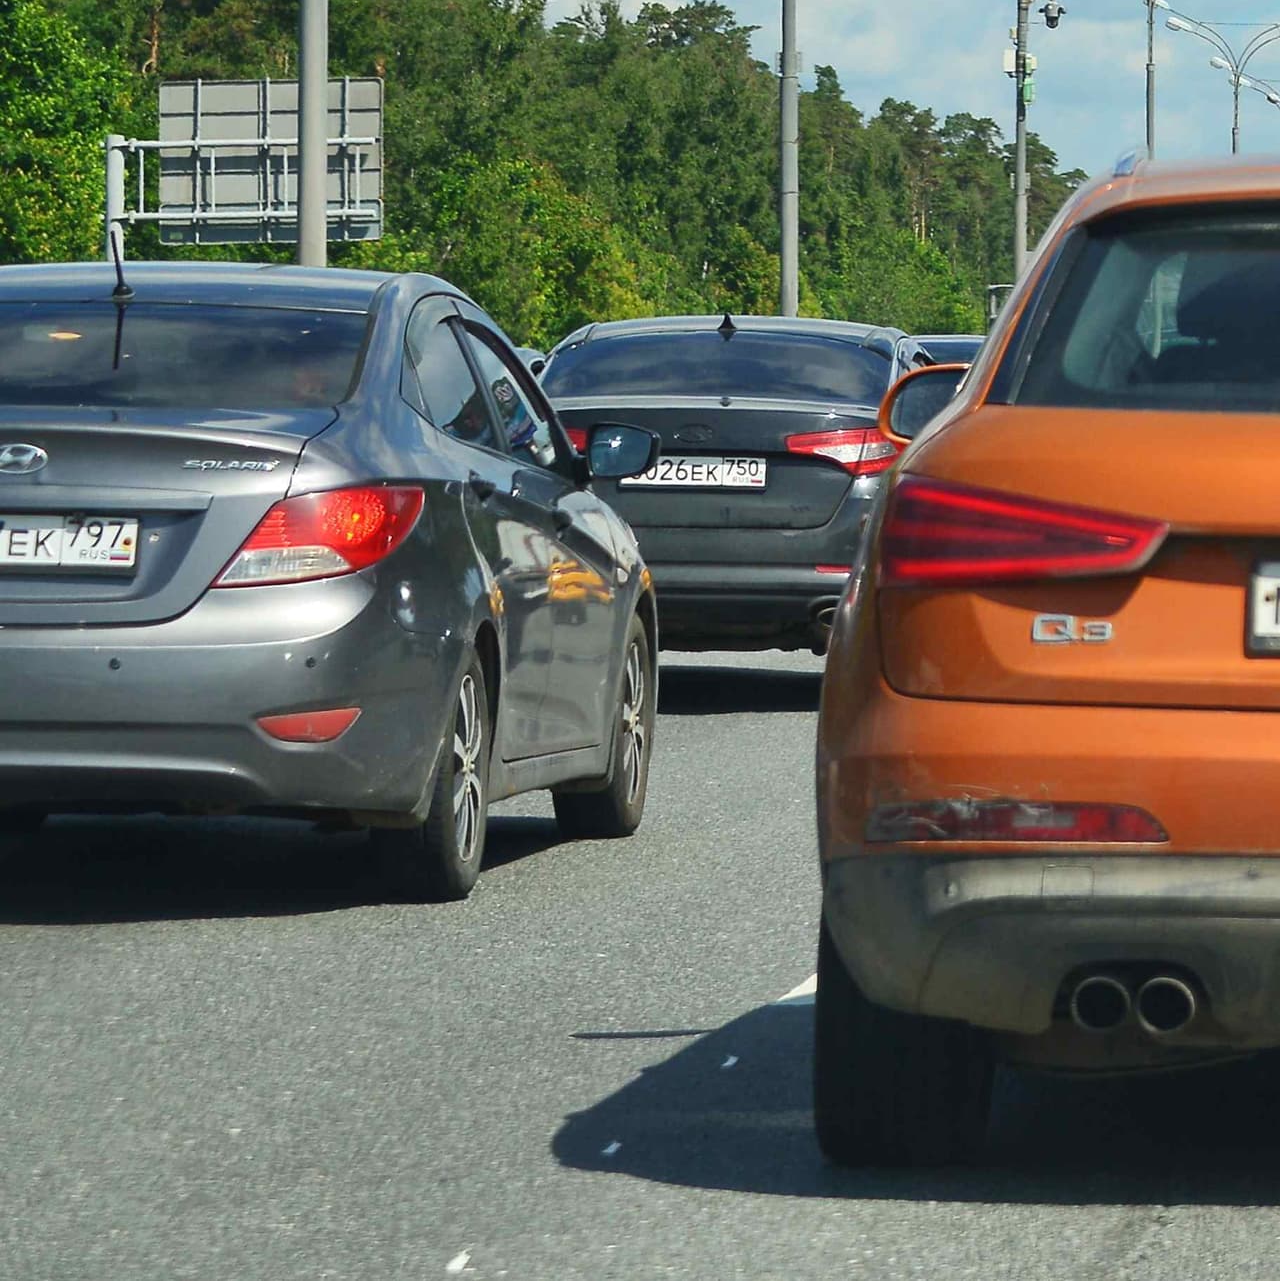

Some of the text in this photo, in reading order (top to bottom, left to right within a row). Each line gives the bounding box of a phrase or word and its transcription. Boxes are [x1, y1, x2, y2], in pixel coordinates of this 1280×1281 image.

[629, 459, 759, 482] 026ЕК 750
[0, 519, 126, 557] ЕК 797
[79, 549, 109, 561] RUS
